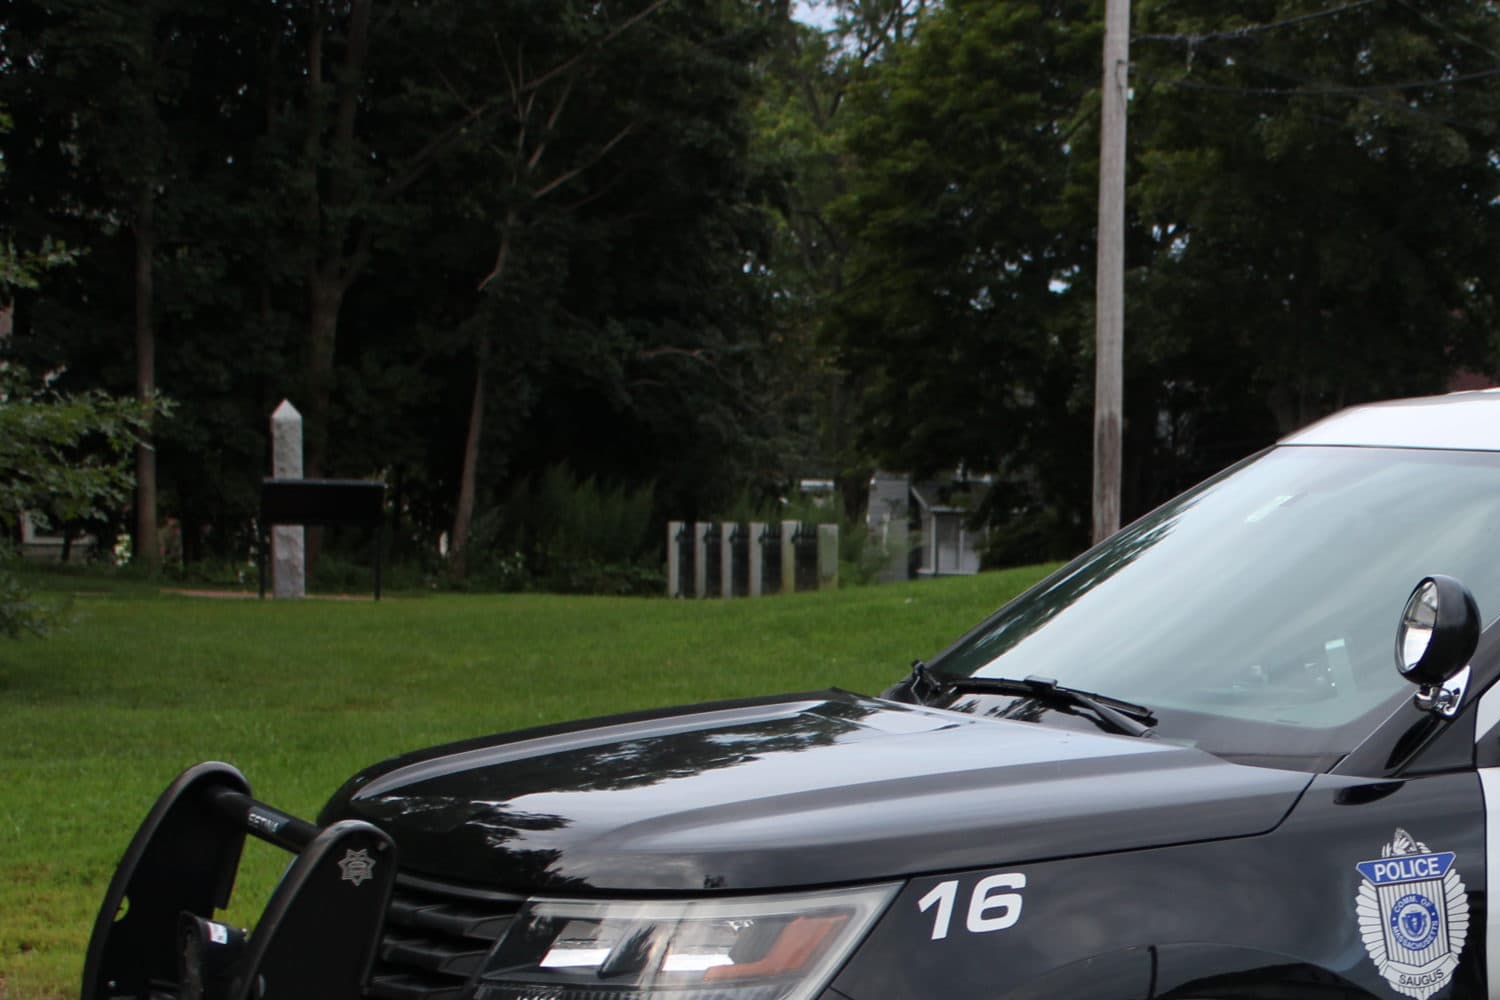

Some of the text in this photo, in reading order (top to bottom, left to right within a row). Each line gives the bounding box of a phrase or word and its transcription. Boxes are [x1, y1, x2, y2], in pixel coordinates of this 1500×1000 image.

[1374, 857, 1441, 881] POLICE
[917, 872, 1027, 940] 16
[1399, 969, 1444, 986] SAUGUS
